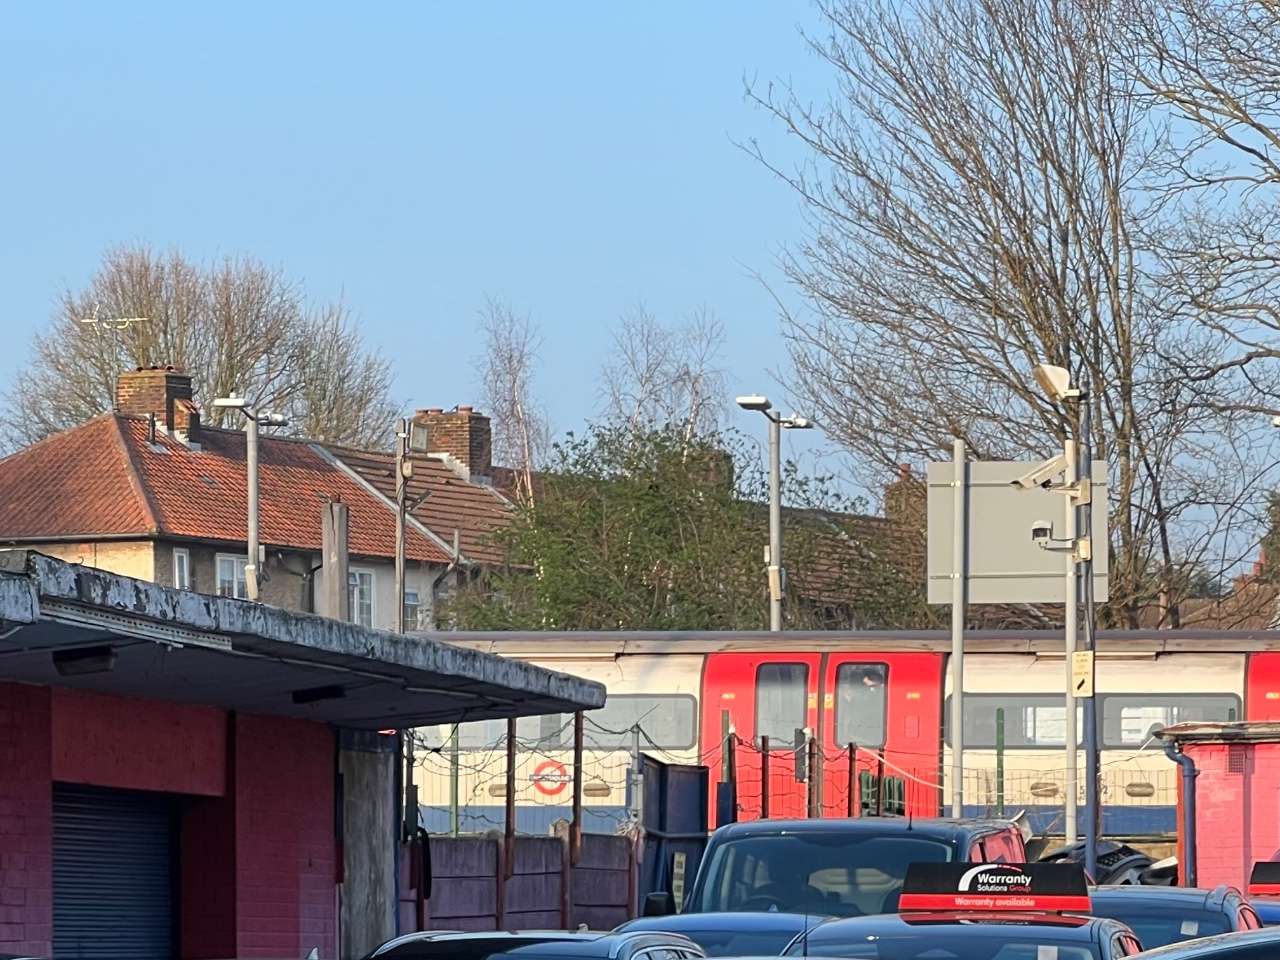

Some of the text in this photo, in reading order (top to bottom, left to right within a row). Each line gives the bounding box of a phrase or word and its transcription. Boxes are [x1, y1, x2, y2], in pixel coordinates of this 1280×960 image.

[977, 873, 1032, 886] Warranty
[977, 884, 1007, 892] Solutions
[955, 898, 1035, 907] Warranty available
